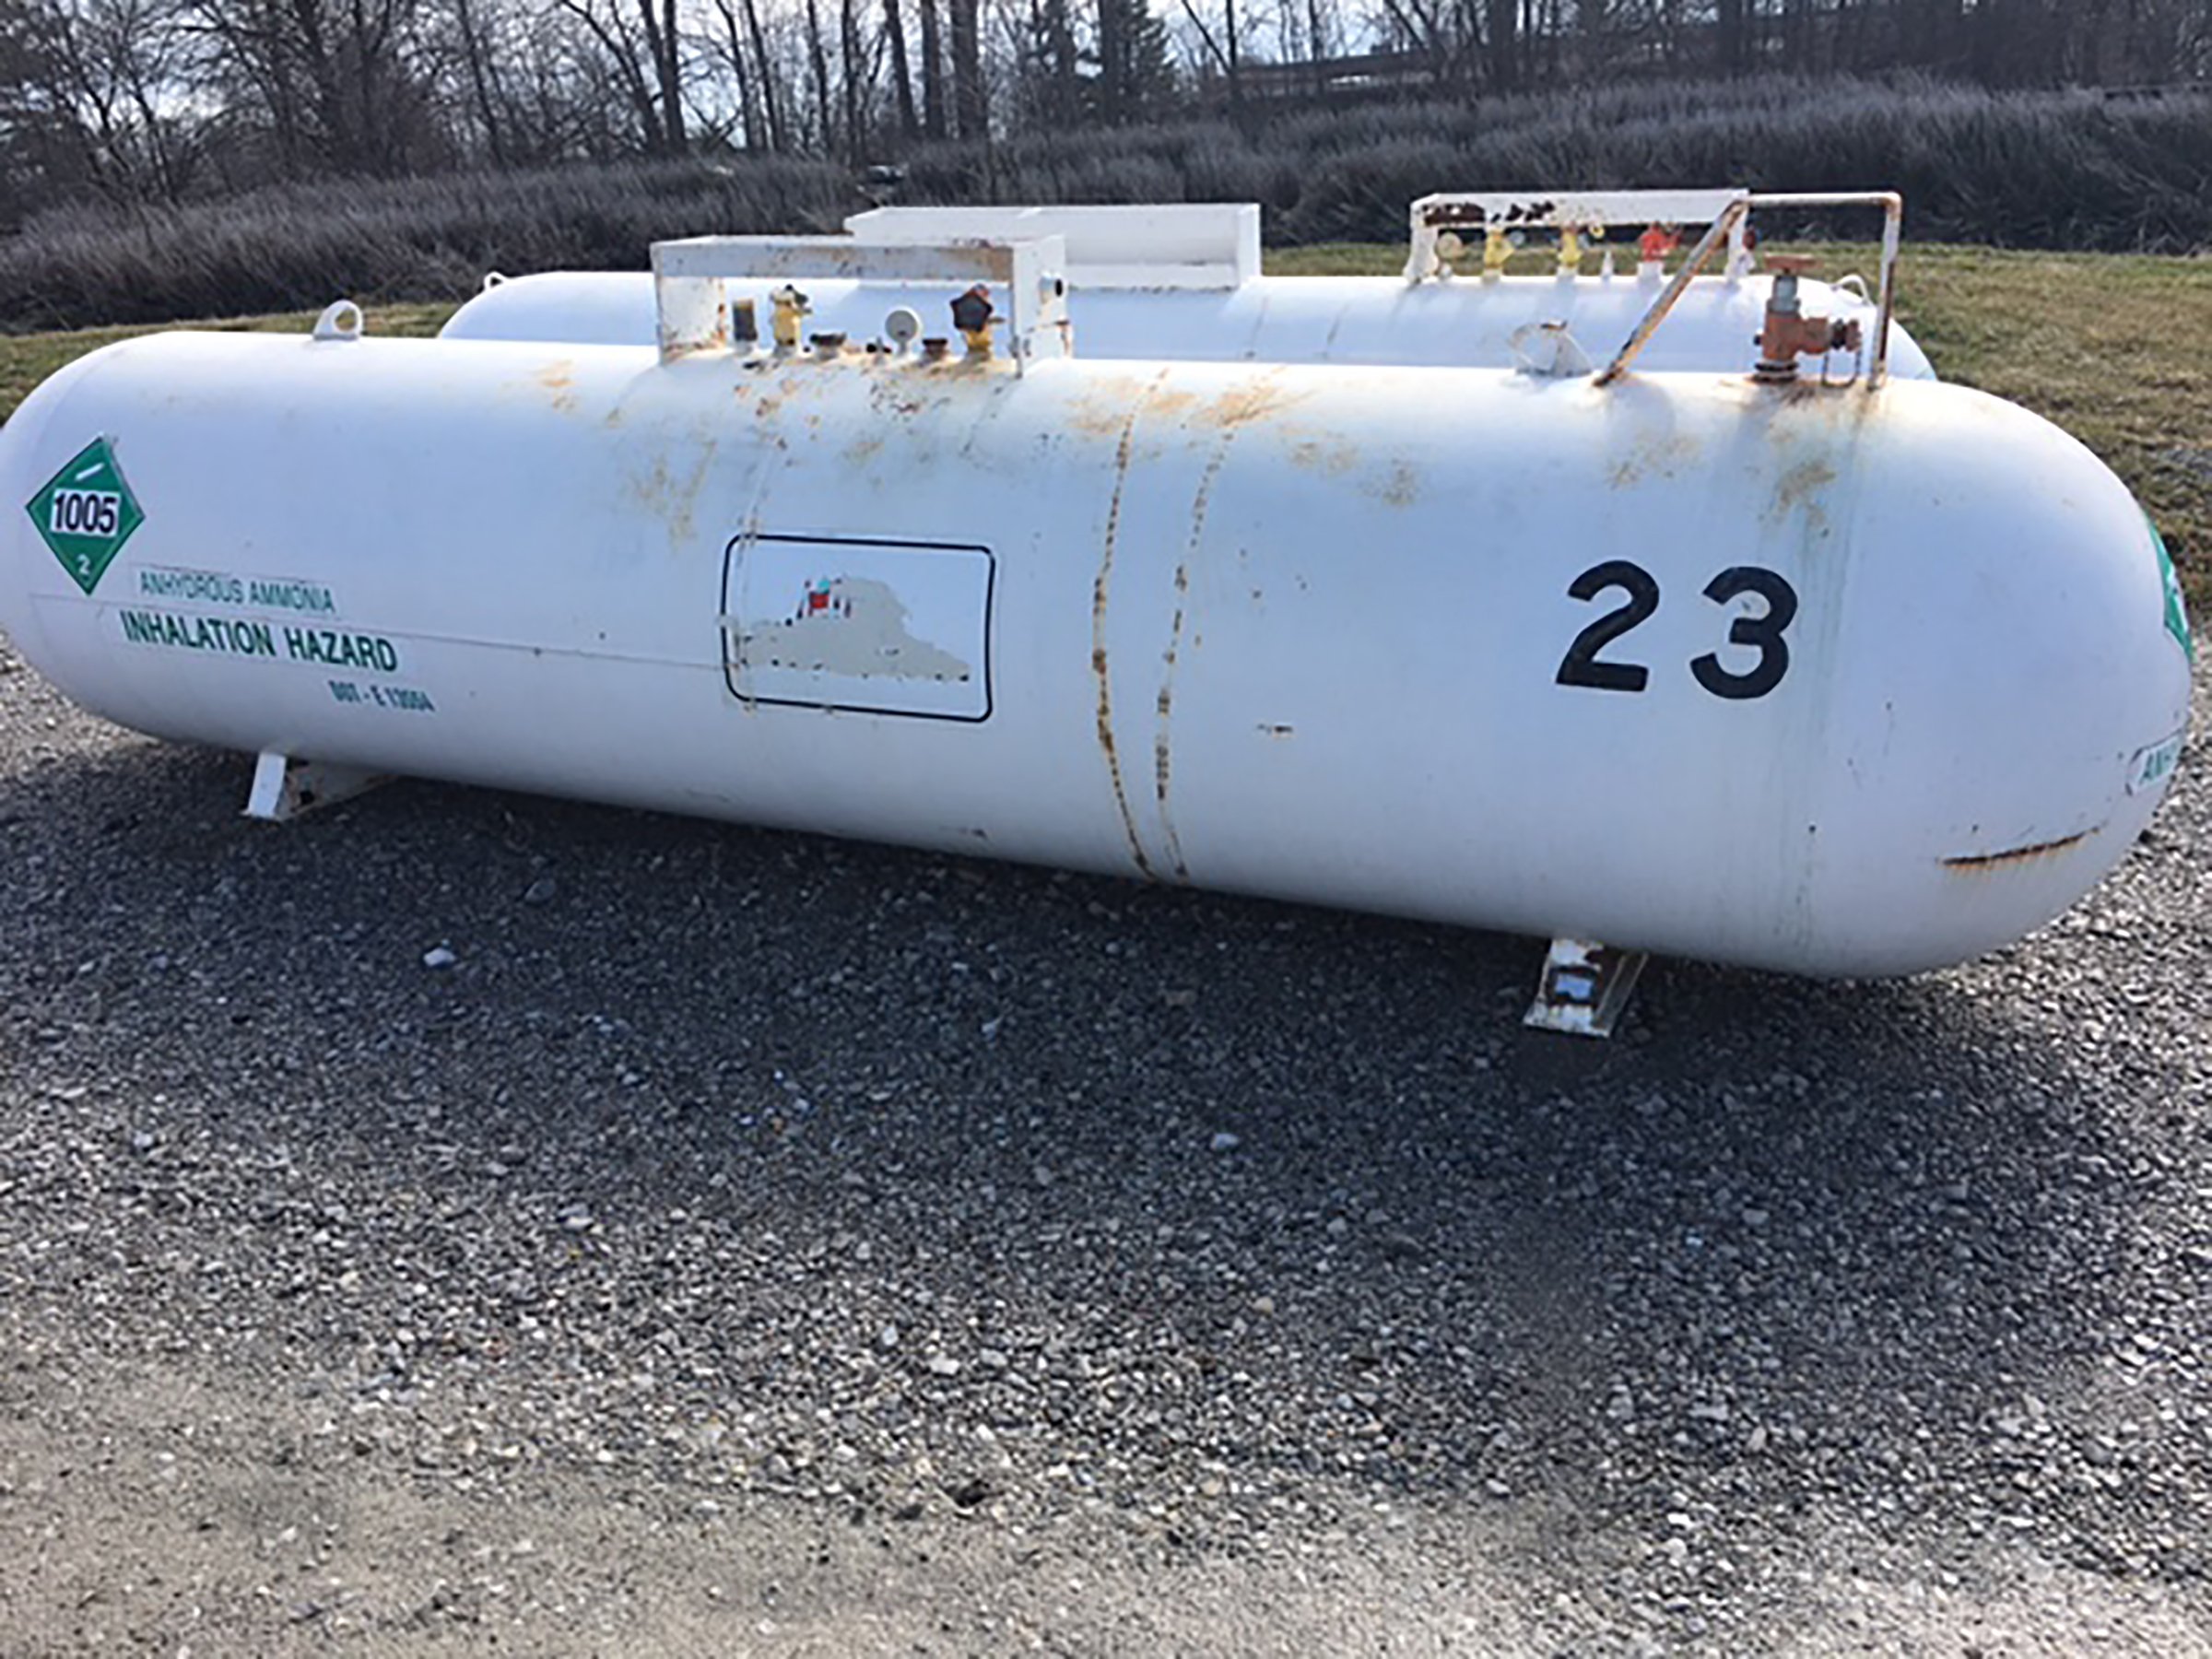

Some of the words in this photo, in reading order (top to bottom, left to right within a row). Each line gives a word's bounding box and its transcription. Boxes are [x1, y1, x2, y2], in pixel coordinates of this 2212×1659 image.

[54, 492, 118, 534] 1005
[76, 554, 90, 574] 2
[140, 571, 243, 604] ANHYDROUS
[249, 580, 335, 613] AMMONIA
[120, 609, 276, 656] INHALATION
[283, 627, 398, 672] HAZARD
[1555, 559, 1798, 700] 23
